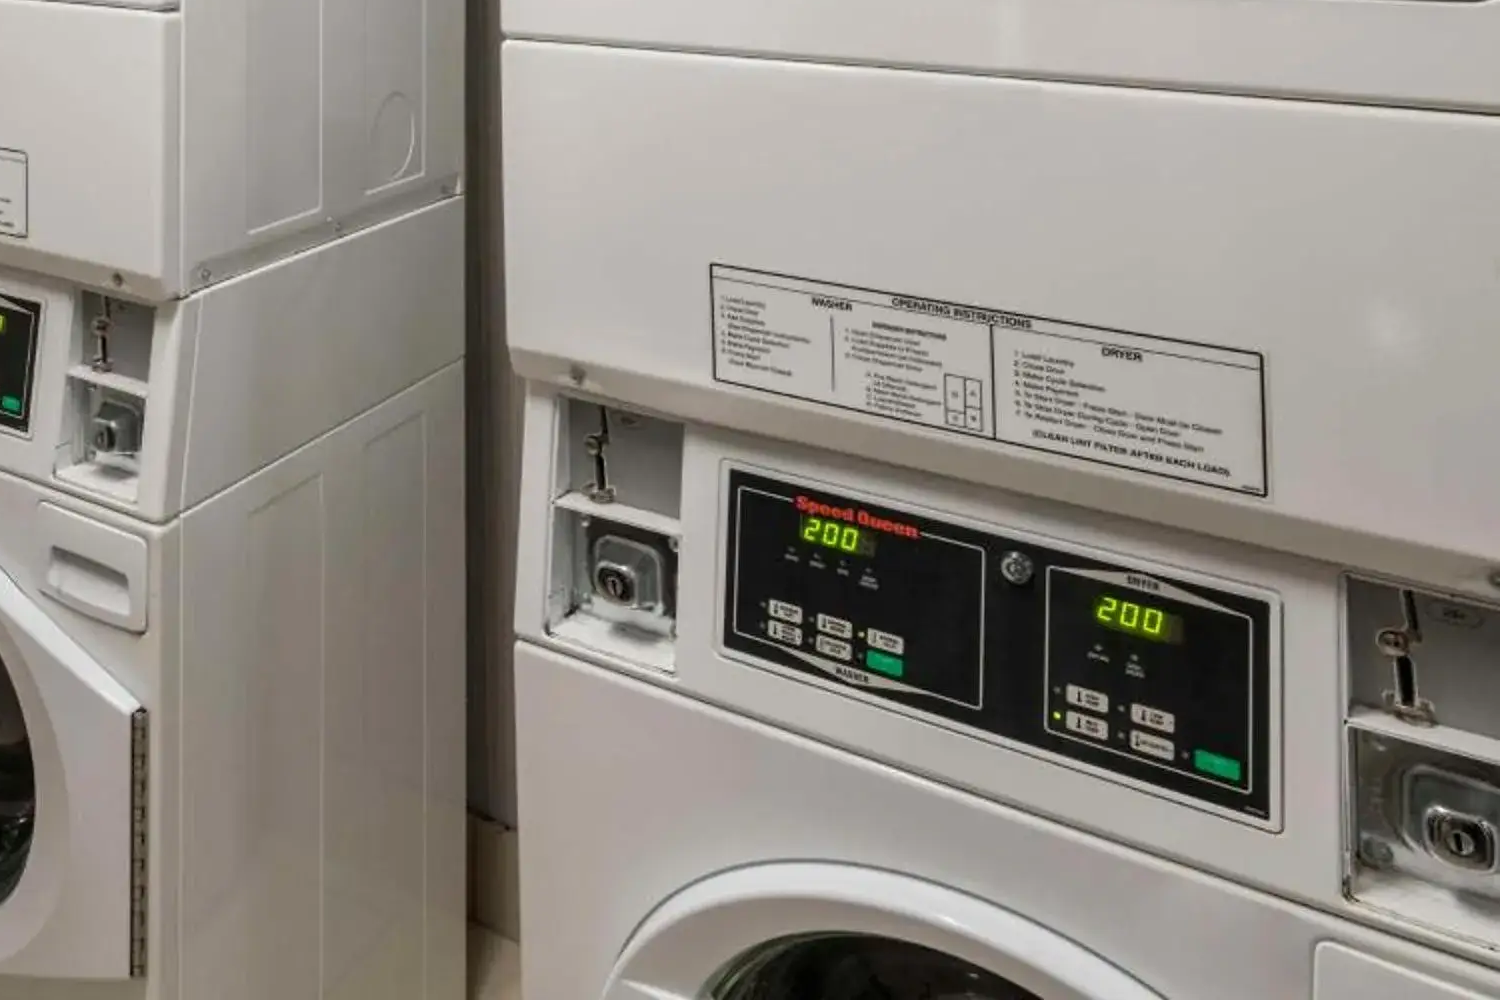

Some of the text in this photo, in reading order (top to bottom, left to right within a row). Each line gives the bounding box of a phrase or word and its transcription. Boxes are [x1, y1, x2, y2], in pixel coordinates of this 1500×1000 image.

[892, 297, 1032, 329] OPERATING INSTRUCTIONS
[1101, 346, 1143, 363] DRYER
[796, 495, 920, 538] Speed Queen
[803, 518, 859, 552] 200
[1097, 596, 1163, 634] 200
